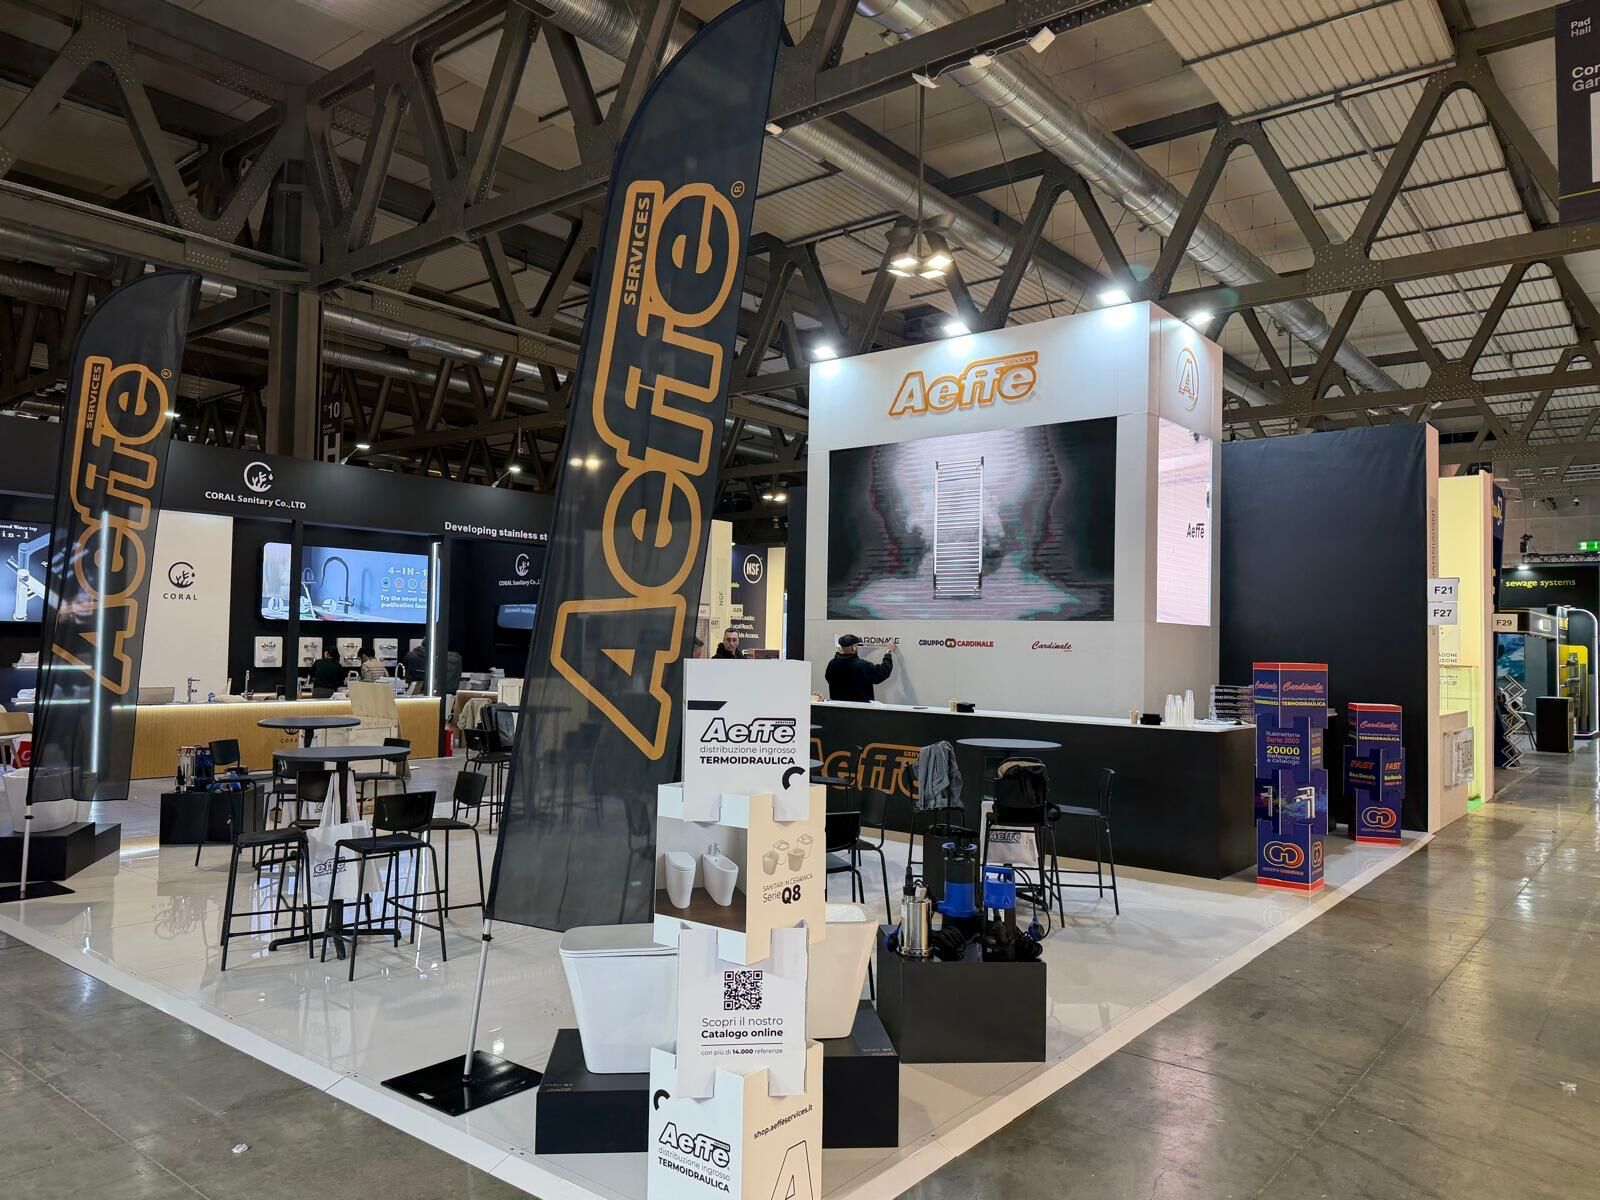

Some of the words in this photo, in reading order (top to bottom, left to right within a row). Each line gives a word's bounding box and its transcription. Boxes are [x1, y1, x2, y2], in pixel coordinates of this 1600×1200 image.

[1571, 17, 1591, 29] Pad
[1571, 26, 1592, 37] Hall
[624, 197, 650, 306] SERVICES
[888, 351, 1039, 417] Aeffe
[86, 365, 103, 430] SERVICES
[328, 401, 341, 420] 10
[550, 180, 740, 760] Aeffe
[205, 491, 236, 502] CORAL
[237, 495, 273, 507] Sanitary
[275, 499, 306, 510] Co.,LTD
[444, 521, 497, 537] Developing
[499, 529, 538, 540] stainless
[1186, 523, 1205, 538] Aeffe
[746, 562, 760, 576] NSF
[1434, 586, 1453, 595] F21
[1505, 580, 1537, 588] sewage
[1540, 580, 1576, 588] systems
[1433, 609, 1452, 618] F27
[919, 639, 944, 647] GRUPPO
[957, 640, 994, 648] CARDINALE
[1032, 640, 1073, 650] Cardinale
[700, 717, 796, 744] Aeffe
[700, 745, 758, 754] distribuzione
[759, 745, 797, 755] ingrosso
[1266, 745, 1300, 755] 20000
[700, 756, 796, 765] TERMOIDRAULICA
[763, 890, 781, 903] Serie
[782, 884, 801, 904] Q8
[702, 1016, 737, 1029] Scopri
[739, 1016, 745, 1026] il
[748, 1017, 784, 1026] nostro
[701, 1028, 748, 1039] Catalogo
[750, 1027, 784, 1037] online
[754, 1104, 813, 1140] shop.aeffeservices.it
[658, 1121, 731, 1168] Aeffe
[658, 1146, 701, 1169] distribuzione
[701, 1164, 731, 1182] ingrosso
[658, 1156, 731, 1194] TERMOIDRAULICA
